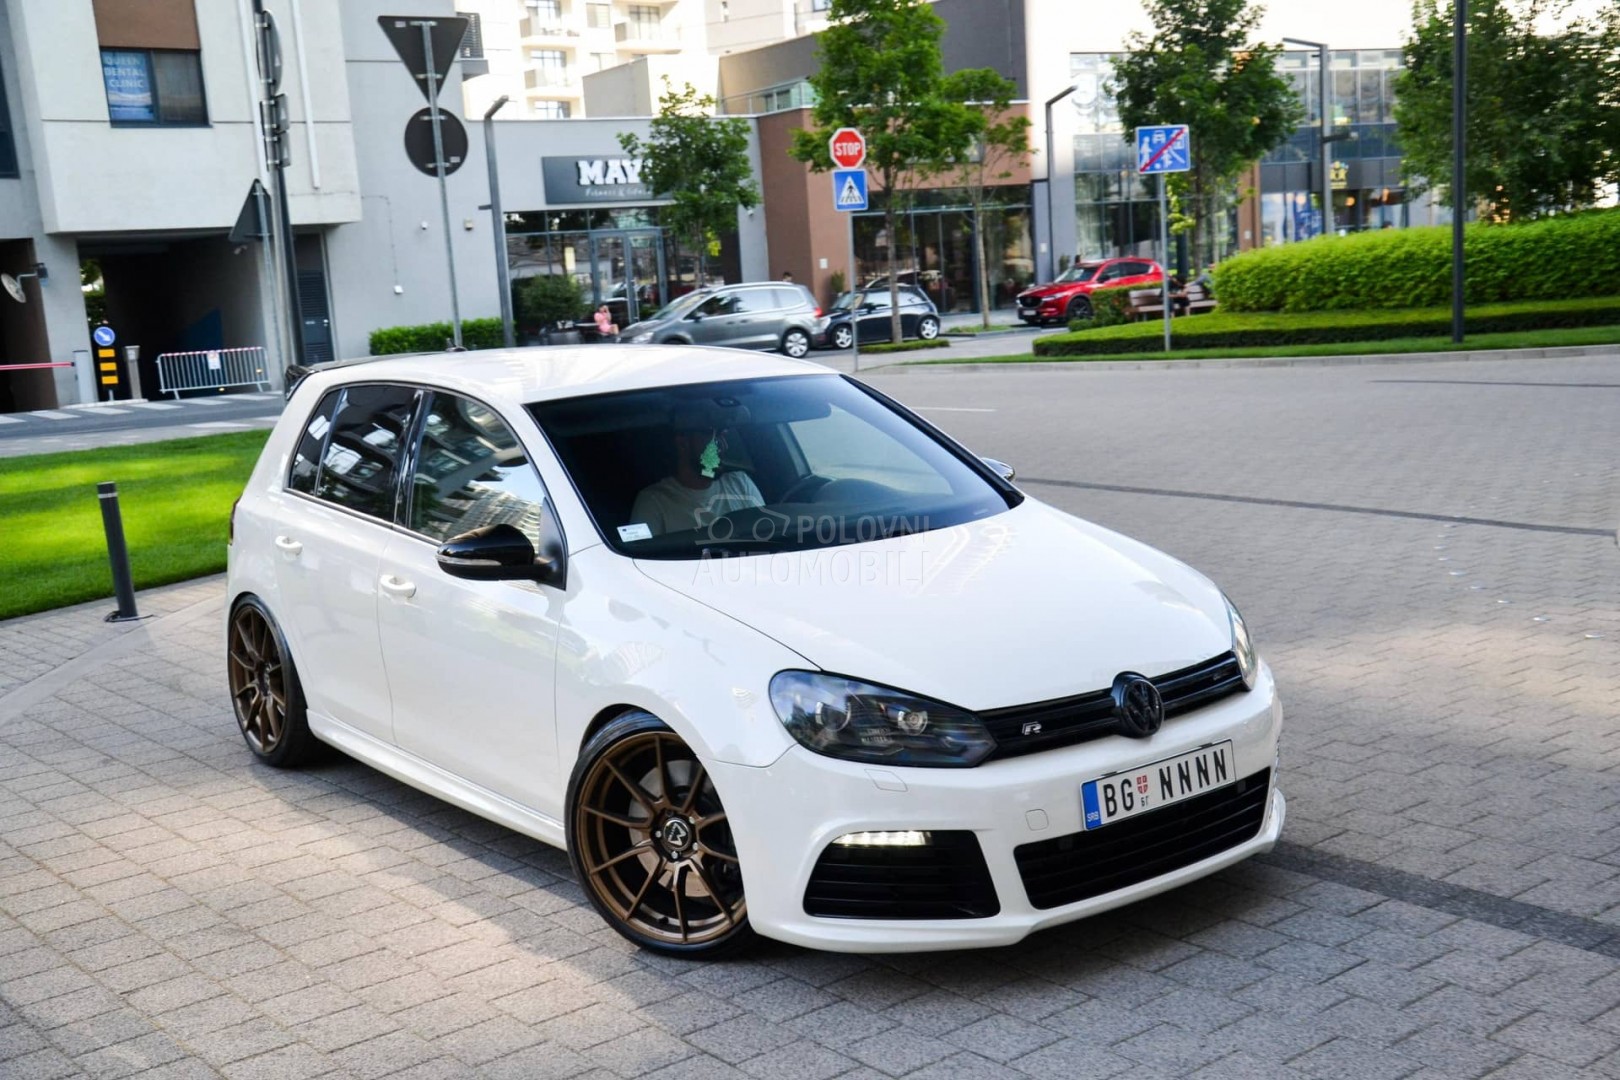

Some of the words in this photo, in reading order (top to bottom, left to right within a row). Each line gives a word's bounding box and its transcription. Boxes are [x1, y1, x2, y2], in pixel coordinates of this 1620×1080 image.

[104, 67, 145, 77] DENTAL
[109, 79, 144, 88] CLINIC
[835, 142, 861, 156] STOP
[1022, 721, 1042, 735] R
[1103, 778, 1134, 818] BG
[1159, 748, 1227, 800] NNNN
[1087, 811, 1099, 822] SRB
